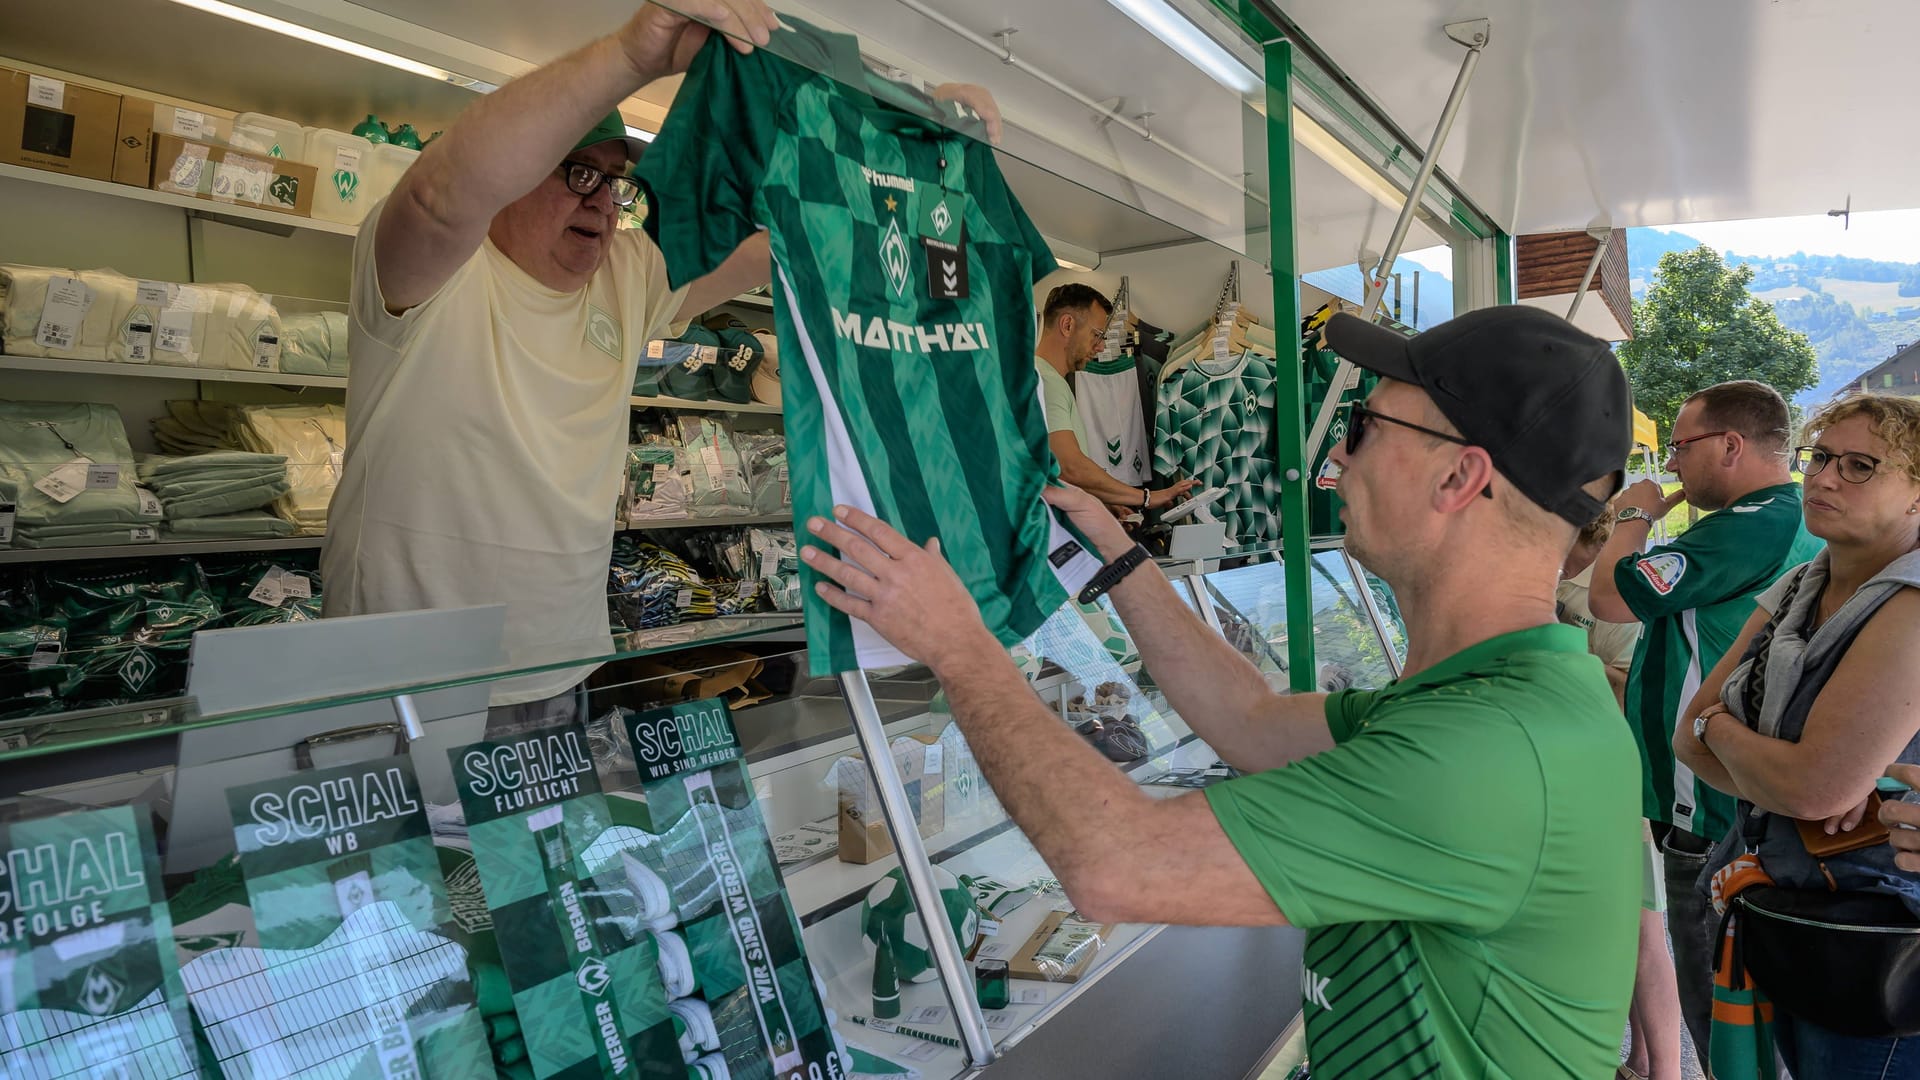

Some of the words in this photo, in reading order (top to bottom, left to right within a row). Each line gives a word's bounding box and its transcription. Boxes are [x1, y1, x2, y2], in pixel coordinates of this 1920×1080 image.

[872, 170, 915, 193] hummel
[831, 304, 989, 354] MATTHÄI
[635, 708, 735, 763] SCHAL
[463, 731, 592, 797] SCHAL
[648, 763, 671, 778] WIR
[673, 756, 697, 773] SIND
[699, 747, 737, 765] WERDER
[250, 768, 419, 847] SCHAL
[494, 776, 579, 813] FLUTLICHT
[559, 880, 593, 953] BREMEN
[737, 915, 763, 962] SIND
[753, 963, 776, 1004] WIR
[594, 1000, 629, 1076] WERDER
